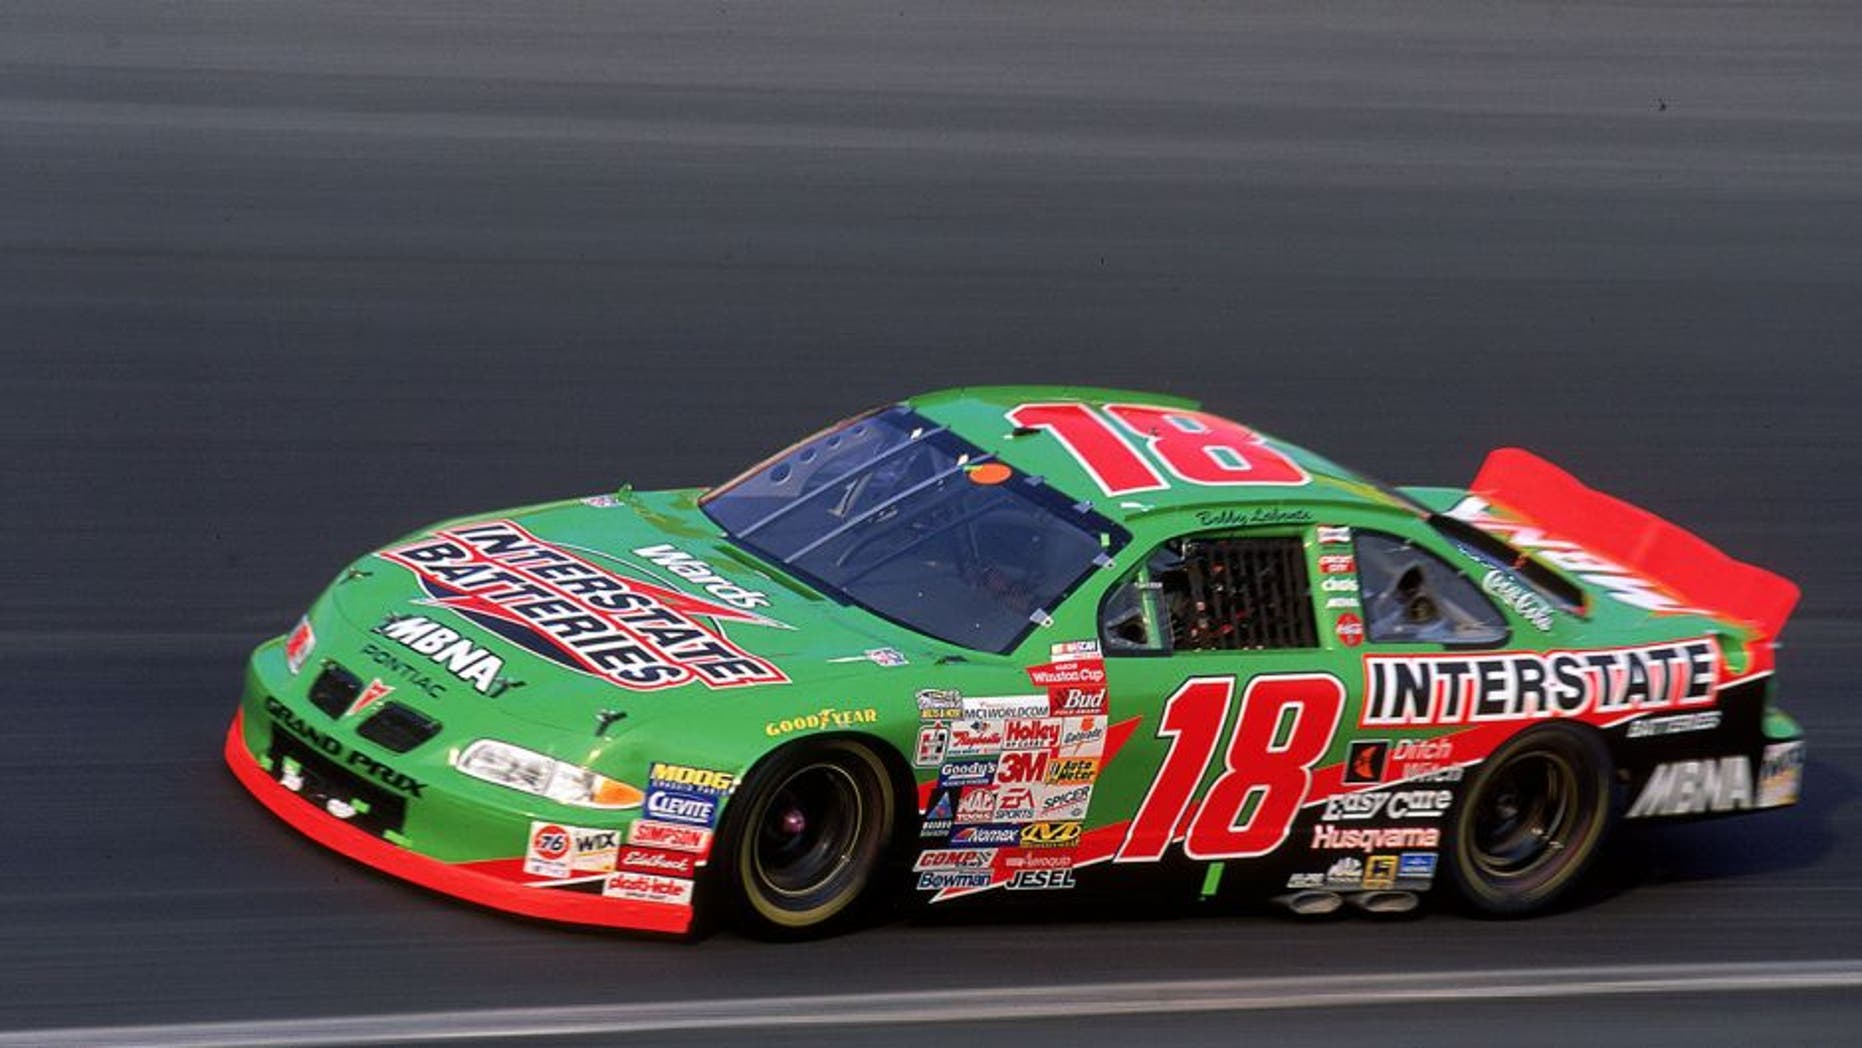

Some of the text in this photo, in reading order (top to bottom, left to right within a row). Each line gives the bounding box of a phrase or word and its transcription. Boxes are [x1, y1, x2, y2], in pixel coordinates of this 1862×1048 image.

[1005, 403, 1312, 497] 18
[1196, 511, 1249, 526] Bobby
[634, 544, 772, 610] Wards
[399, 542, 684, 684] BATTERIES
[453, 523, 767, 681] INTERSTATE
[382, 616, 503, 695] MBNA
[362, 644, 446, 699] PONTIAC
[1032, 669, 1104, 683] Winston Cup
[1369, 638, 1717, 713] INTERSTATE
[1064, 688, 1108, 709] Bud
[1006, 720, 1060, 746] Holley
[1626, 711, 1723, 738] BATTERIES
[265, 696, 428, 799] GRAND PRIX
[1393, 739, 1453, 761] Ditch
[650, 763, 733, 790] MOOG
[942, 762, 996, 778] Goody's
[998, 753, 1048, 783] 3M
[1063, 760, 1092, 769] Auto
[1113, 672, 1347, 862] 18
[1042, 786, 1091, 809] SPICER
[1624, 756, 1752, 818] MBNA
[995, 809, 1034, 819] SPORTS
[540, 834, 563, 851] 76
[576, 831, 617, 852] WIX
[634, 824, 702, 846] SIMPSON
[967, 829, 1020, 844] Nomex
[1311, 824, 1441, 852] Husqvarna
[919, 851, 978, 868] COMP
[920, 872, 991, 887] Bowman
[1006, 869, 1077, 890] JESEL
